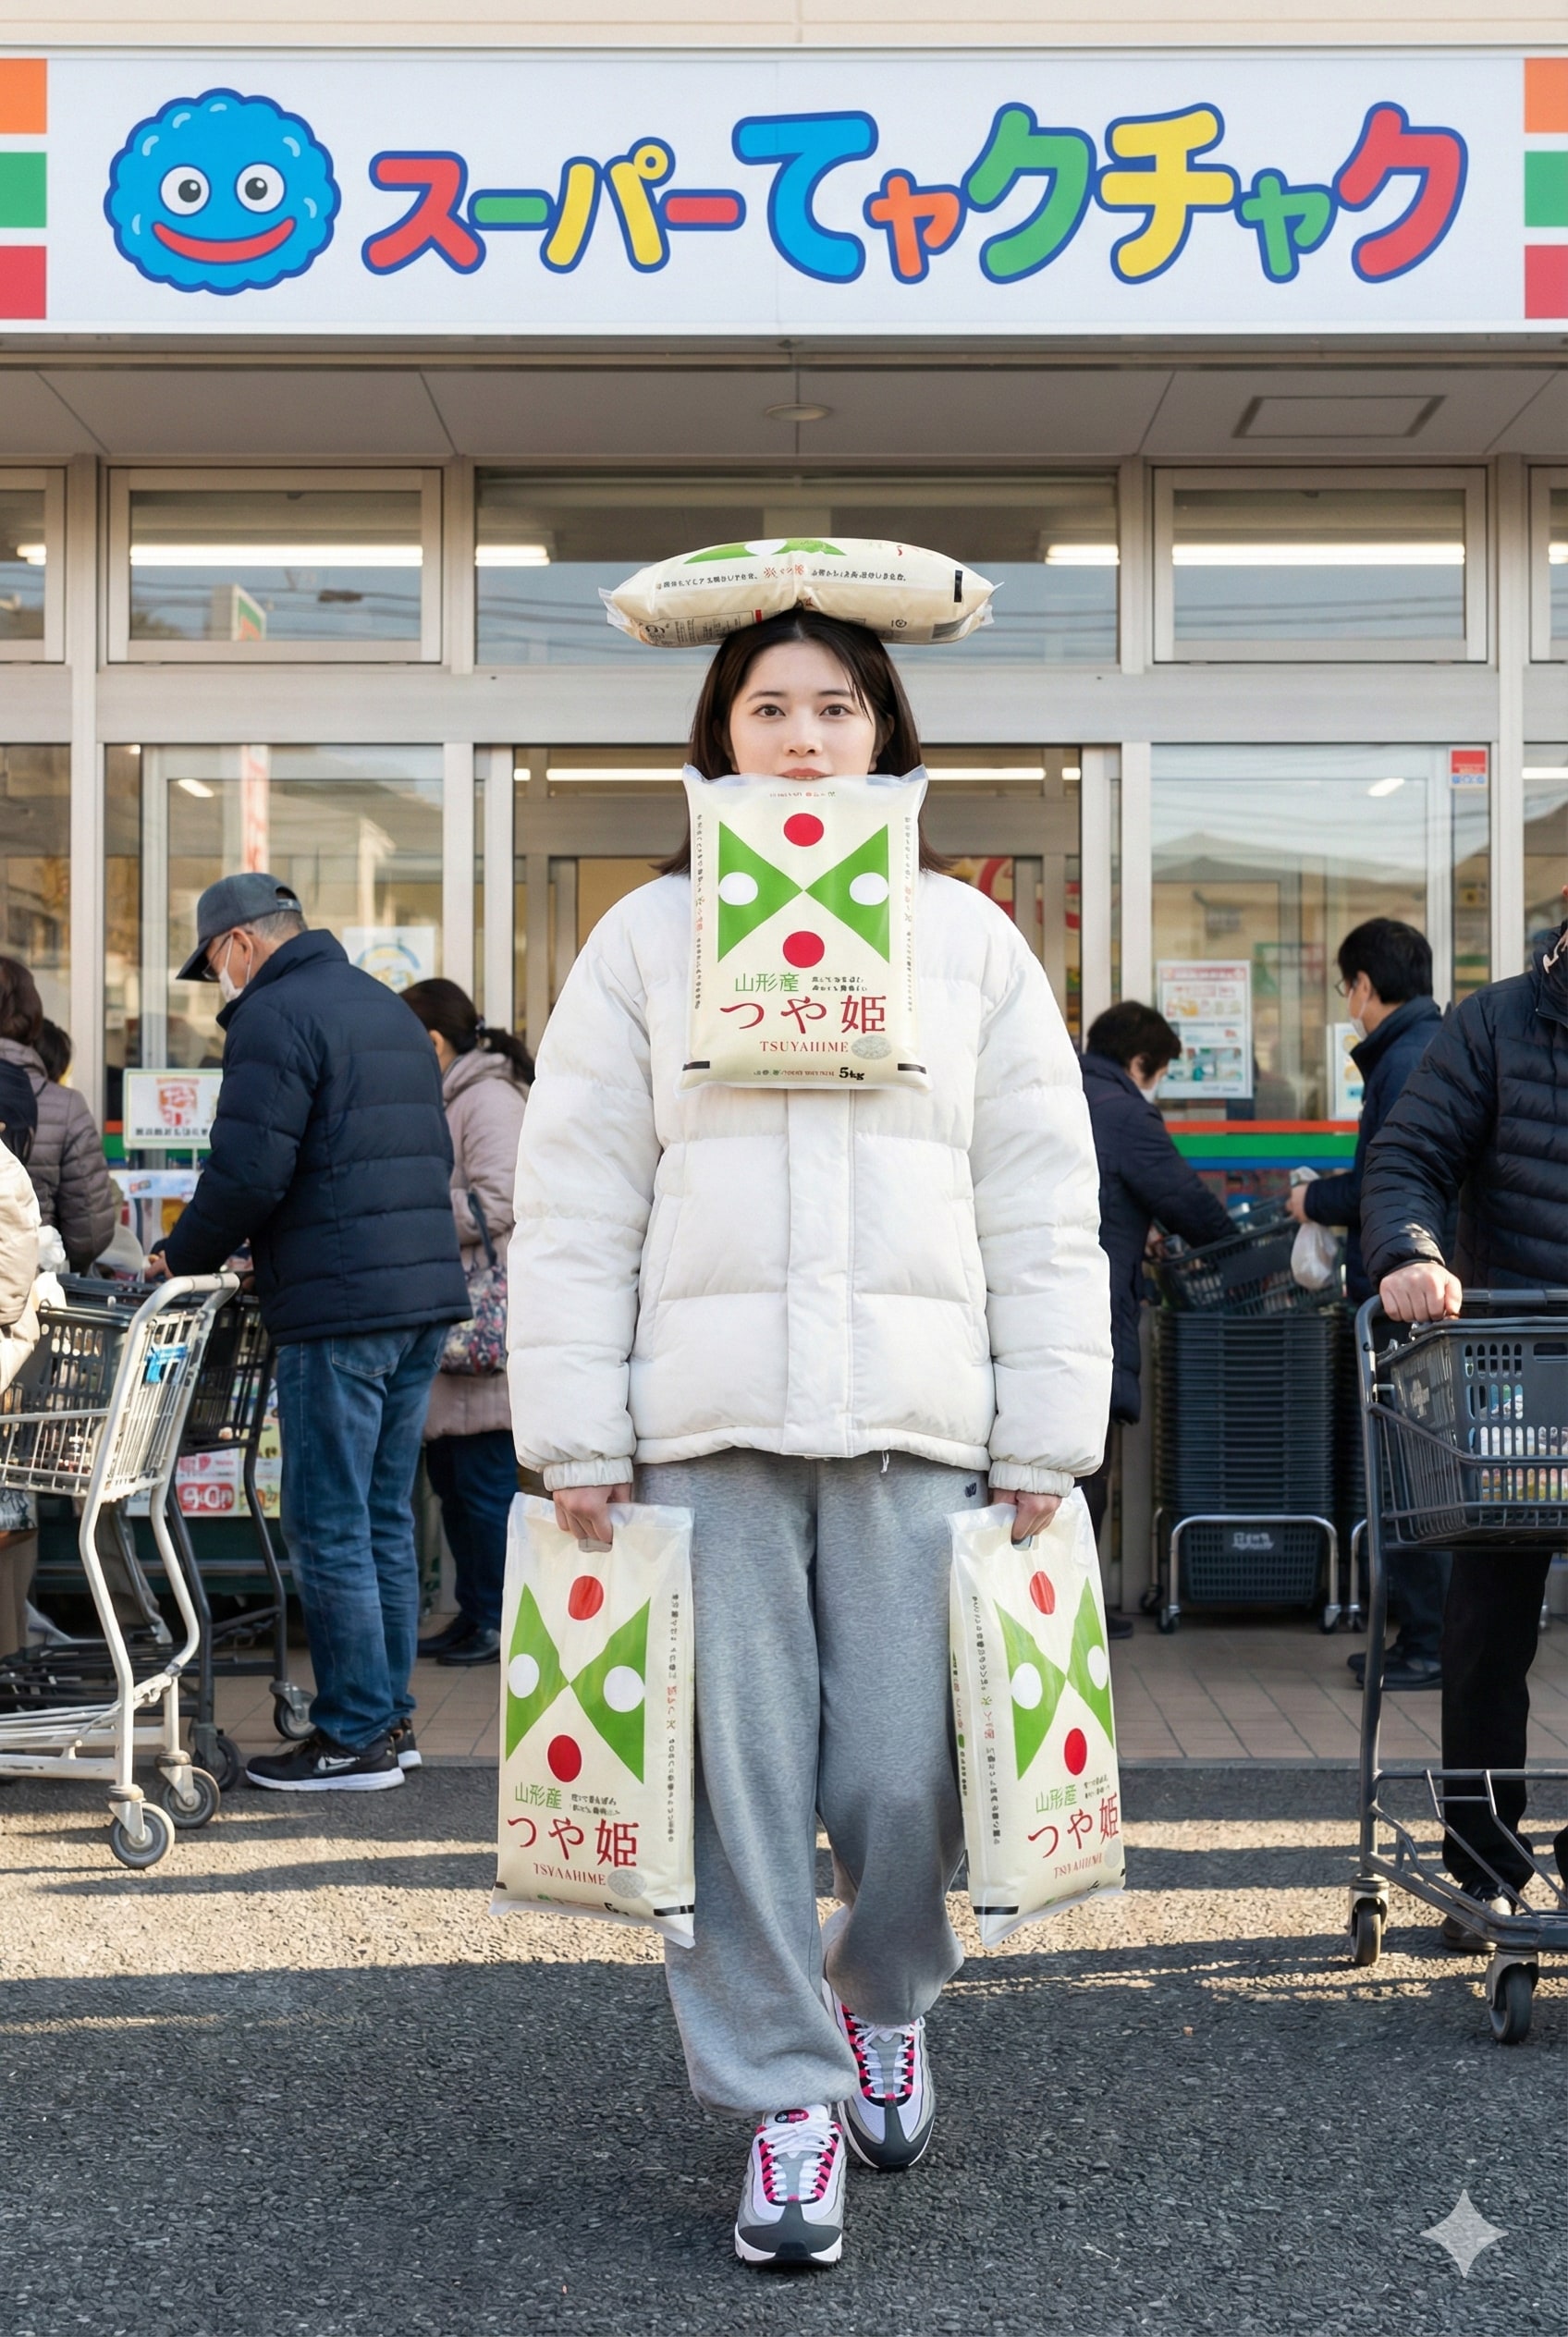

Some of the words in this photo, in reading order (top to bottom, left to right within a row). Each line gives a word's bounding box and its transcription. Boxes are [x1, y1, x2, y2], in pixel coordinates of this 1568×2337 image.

[735, 972, 800, 993] 山形産
[719, 995, 887, 1034] つや姫
[839, 1067, 865, 1081] 5kg
[514, 1781, 562, 1809] 山形産
[507, 1817, 640, 1867] つや姫
[1027, 1792, 1119, 1859] つや姫
